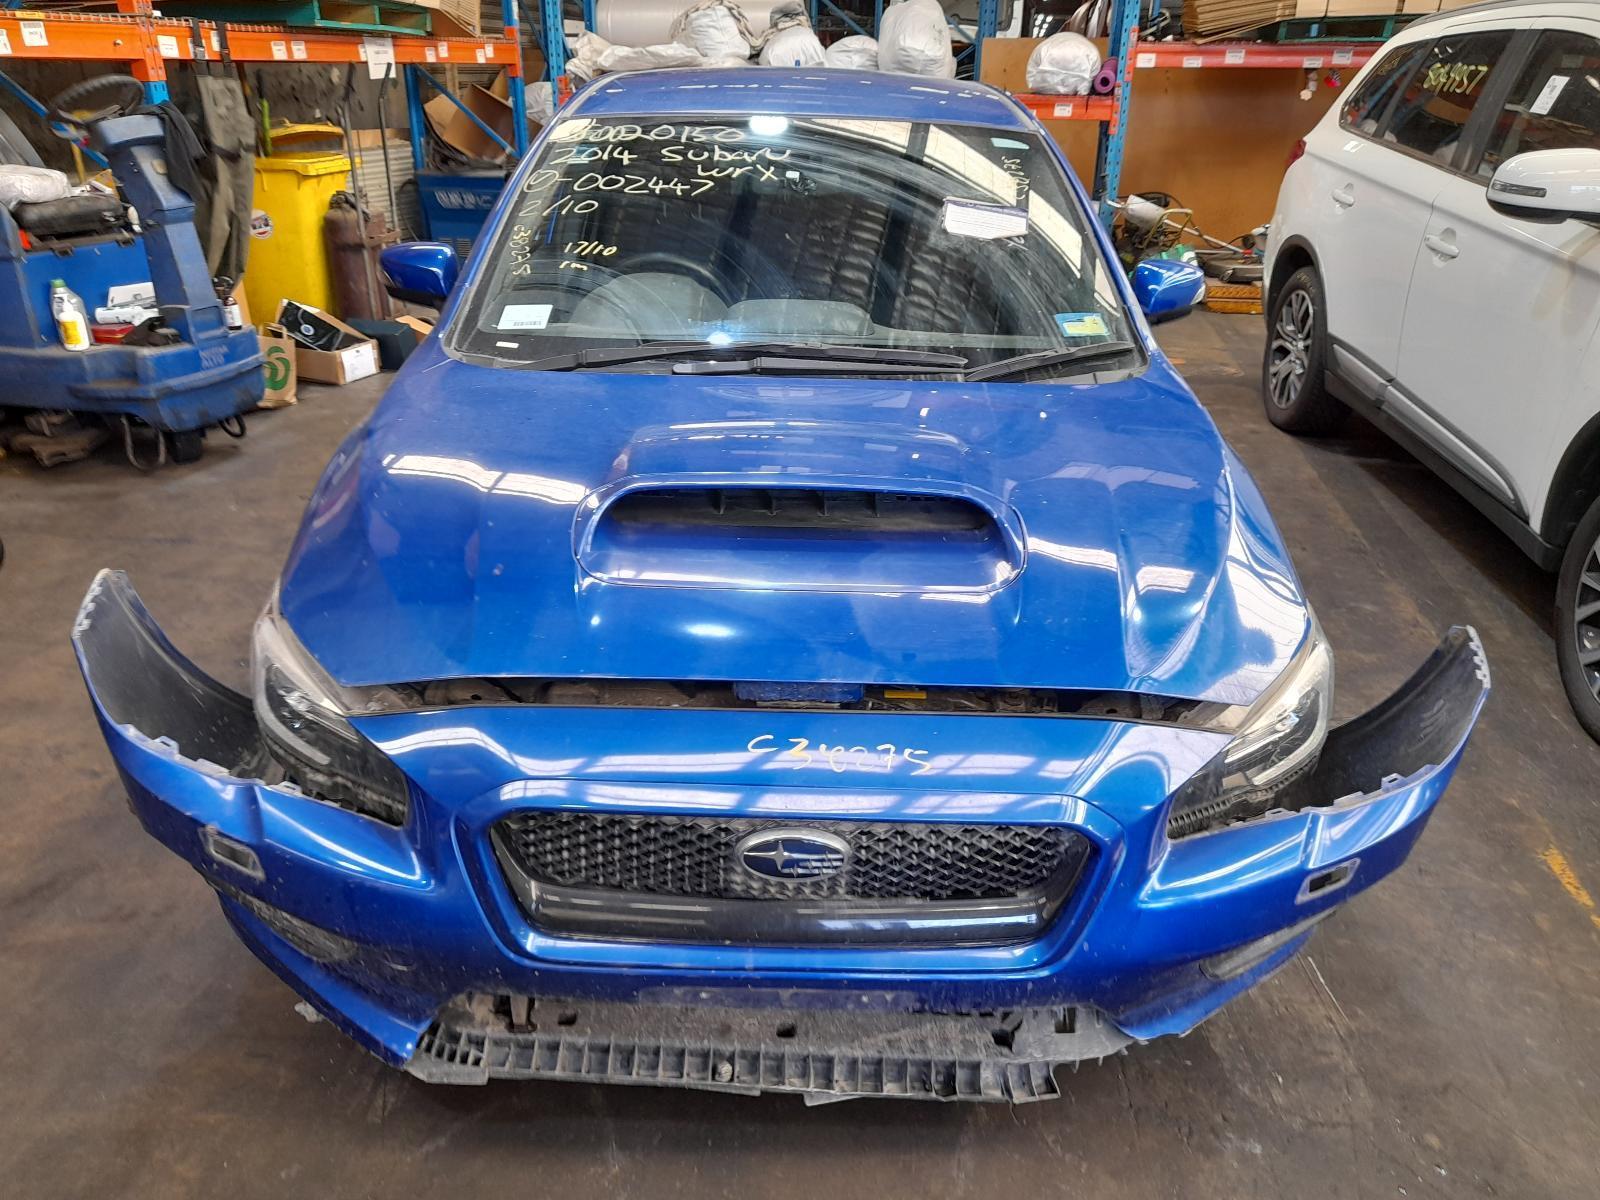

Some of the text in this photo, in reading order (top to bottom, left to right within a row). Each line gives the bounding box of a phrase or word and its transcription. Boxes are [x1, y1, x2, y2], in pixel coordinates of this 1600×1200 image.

[550, 144, 791, 165] 2014 Subaru
[518, 194, 599, 217] 2/10
[563, 240, 618, 256] 17/10
